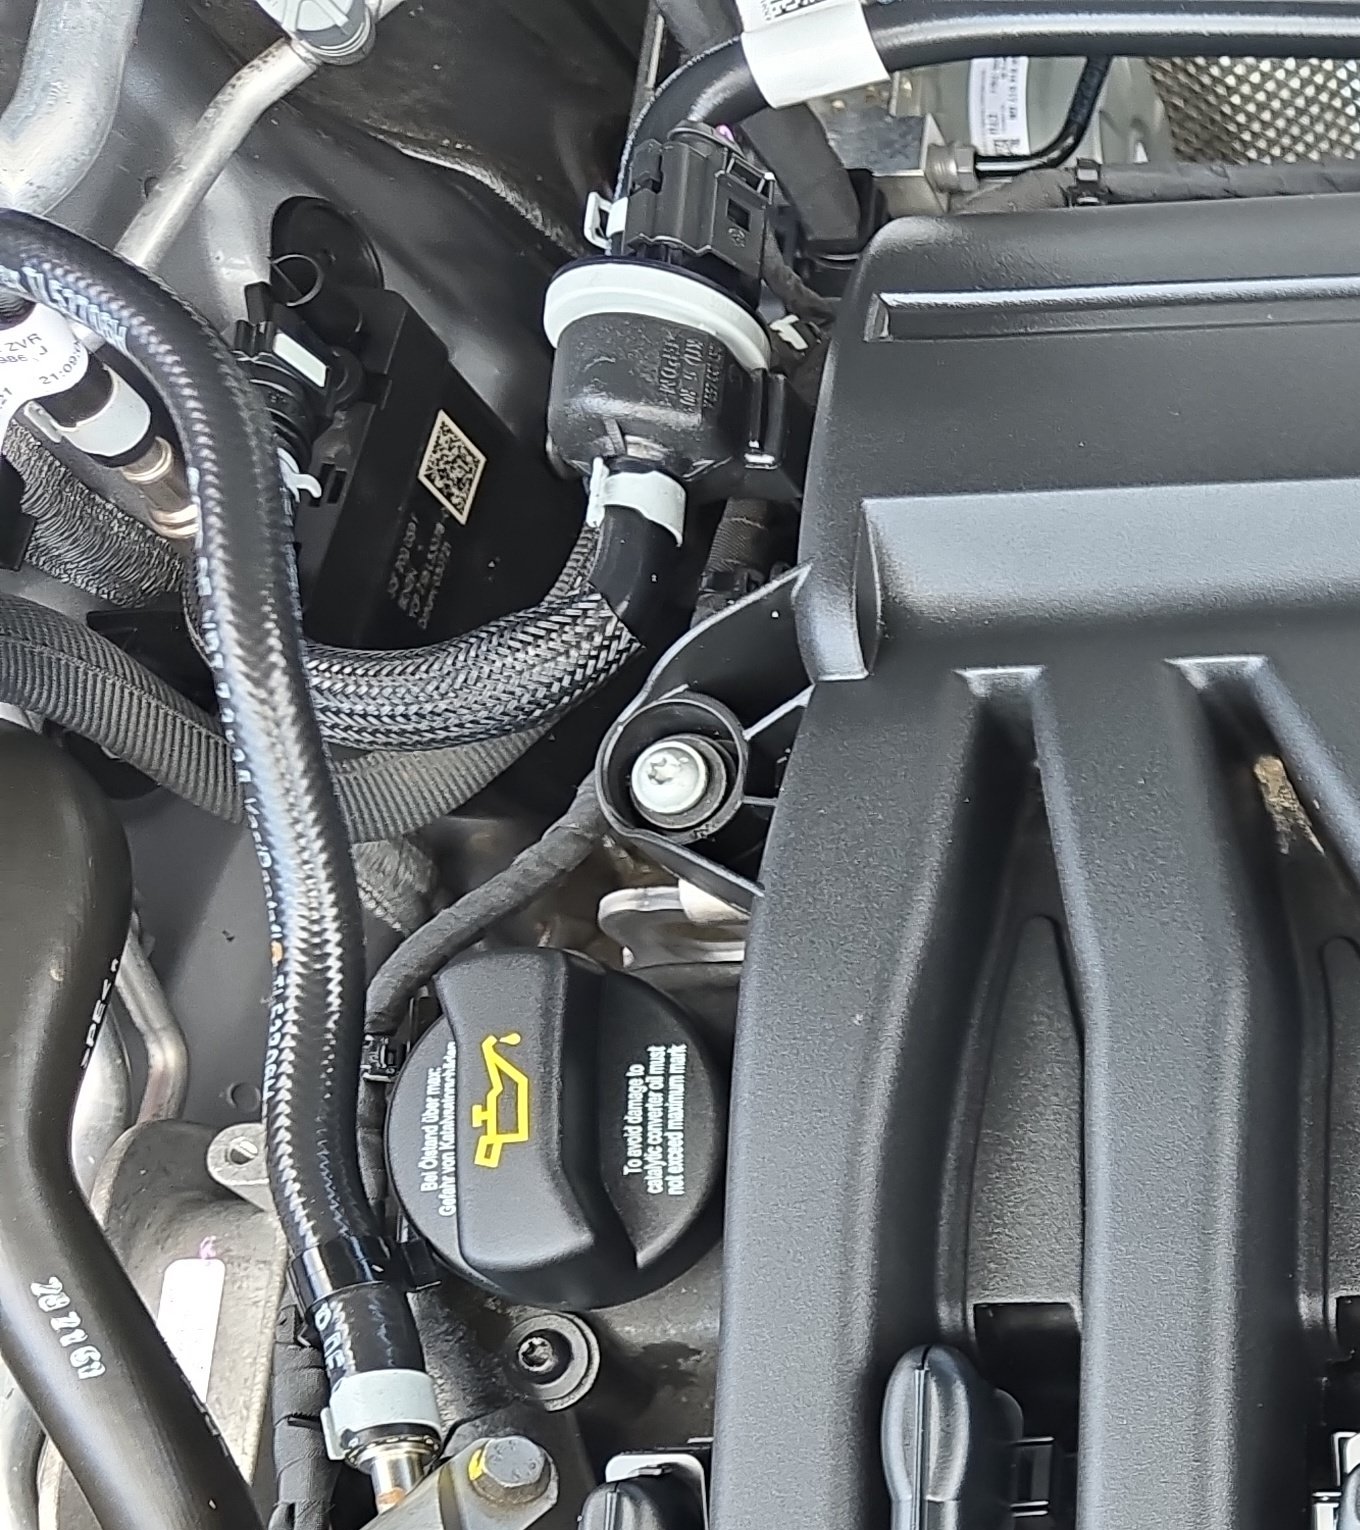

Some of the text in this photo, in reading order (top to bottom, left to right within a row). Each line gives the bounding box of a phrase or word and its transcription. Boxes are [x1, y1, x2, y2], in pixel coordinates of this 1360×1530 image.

[417, 1125, 438, 1170] Ölstand
[441, 1151, 455, 1174] von
[622, 1064, 648, 1176] To avoid damage to
[643, 1046, 667, 1194] catalytic converter oil must
[663, 1043, 687, 1195] not exceed maximum mark
